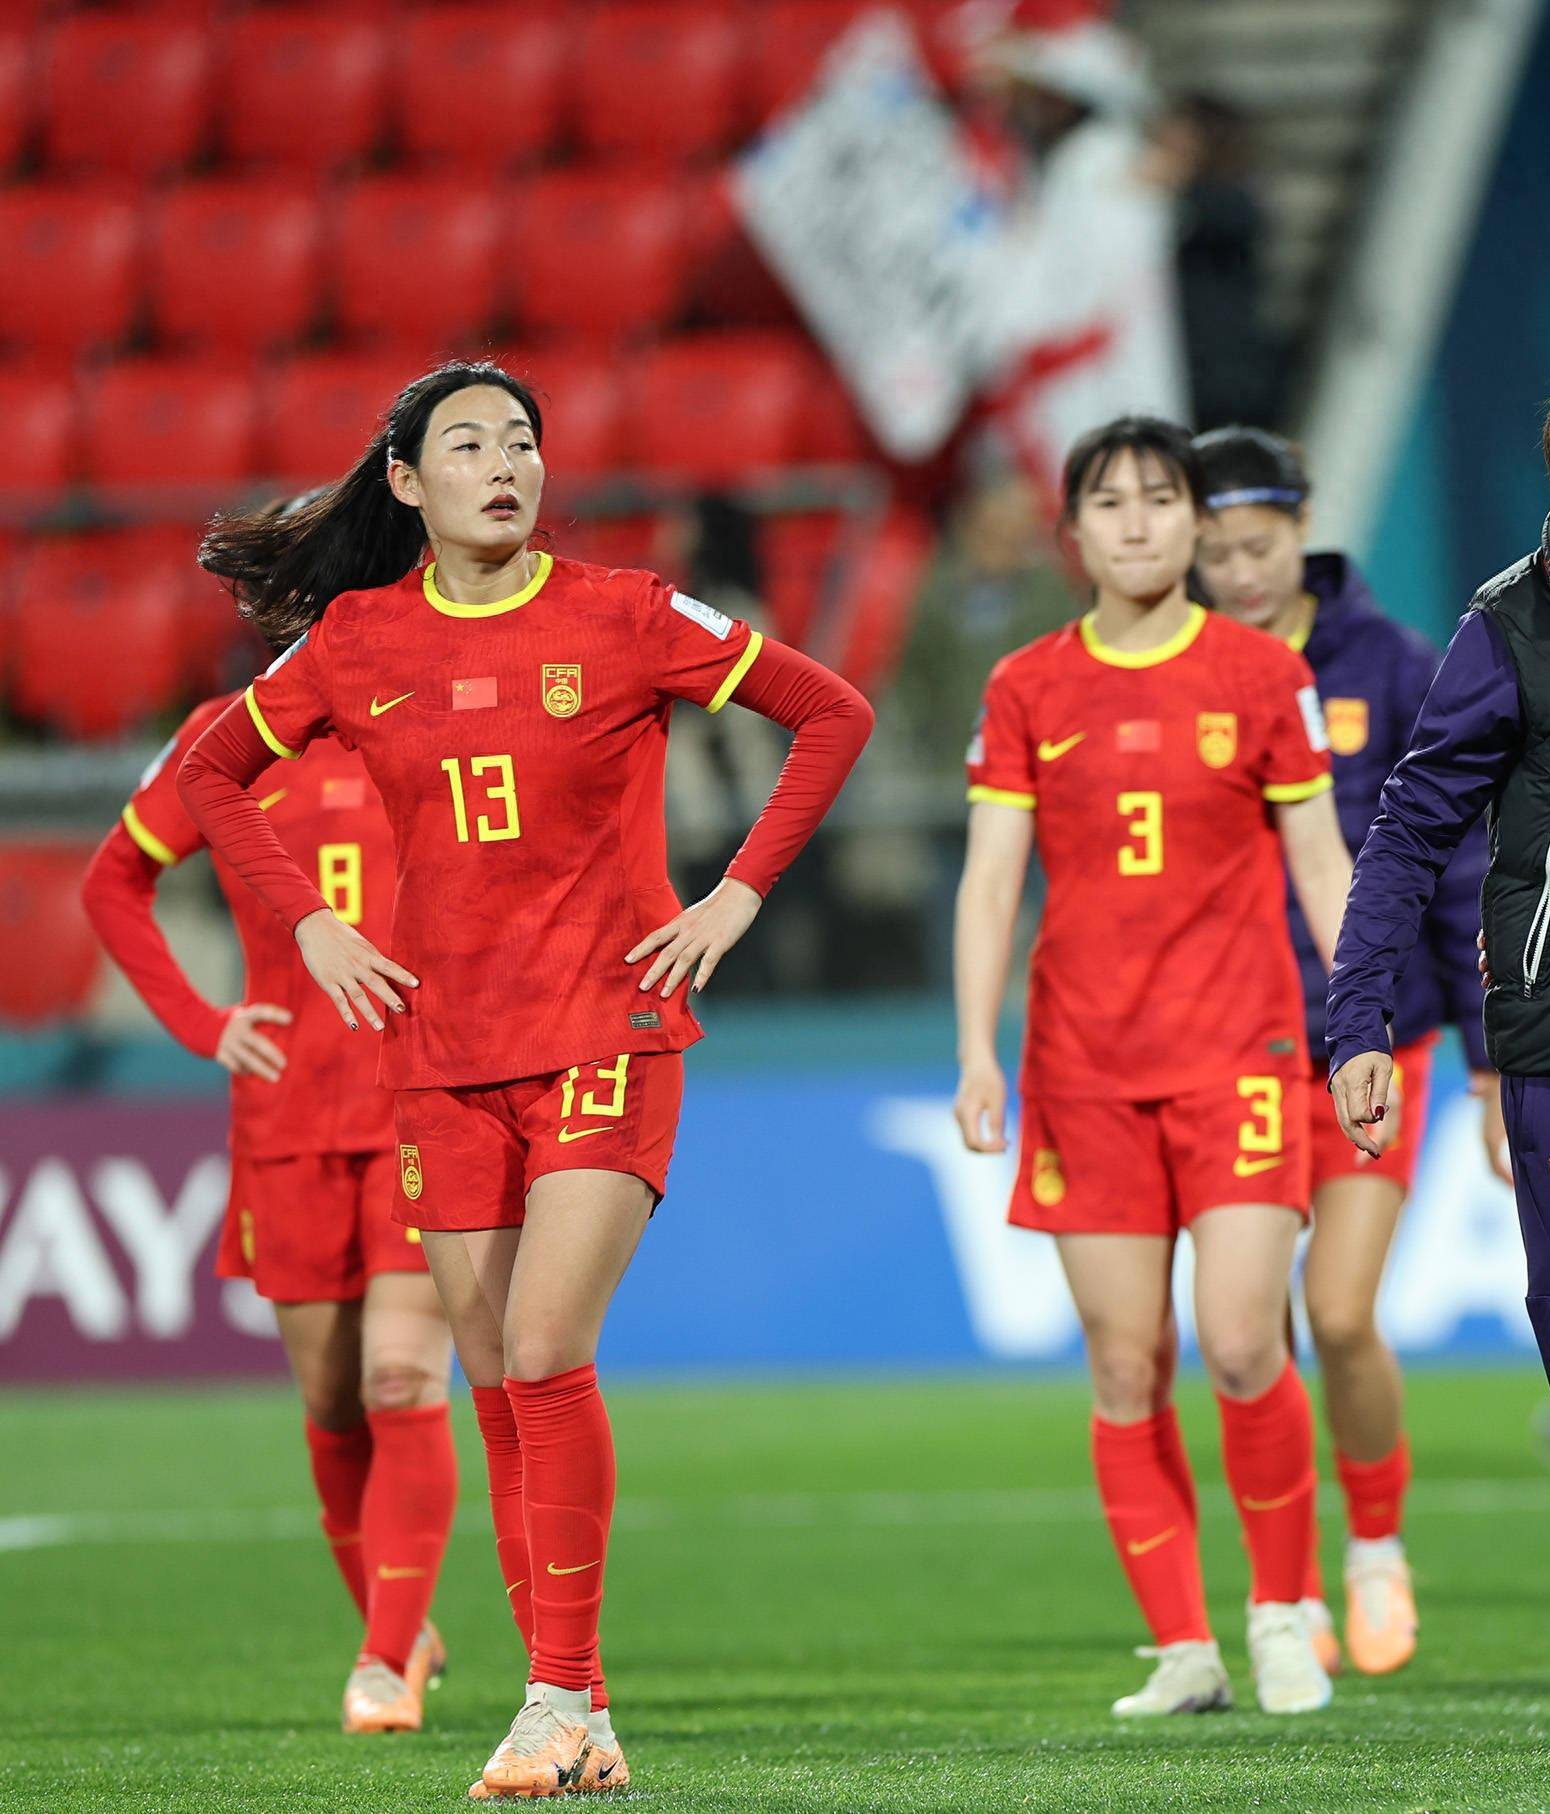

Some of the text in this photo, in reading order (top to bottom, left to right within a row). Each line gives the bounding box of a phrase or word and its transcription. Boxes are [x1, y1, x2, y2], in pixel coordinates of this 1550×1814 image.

[546, 667, 578, 678] CFA
[441, 754, 521, 843] 13
[1117, 791, 1163, 876] 3
[318, 843, 362, 925] 8
[561, 1053, 630, 1118] 13
[1236, 1075, 1283, 1153] 3
